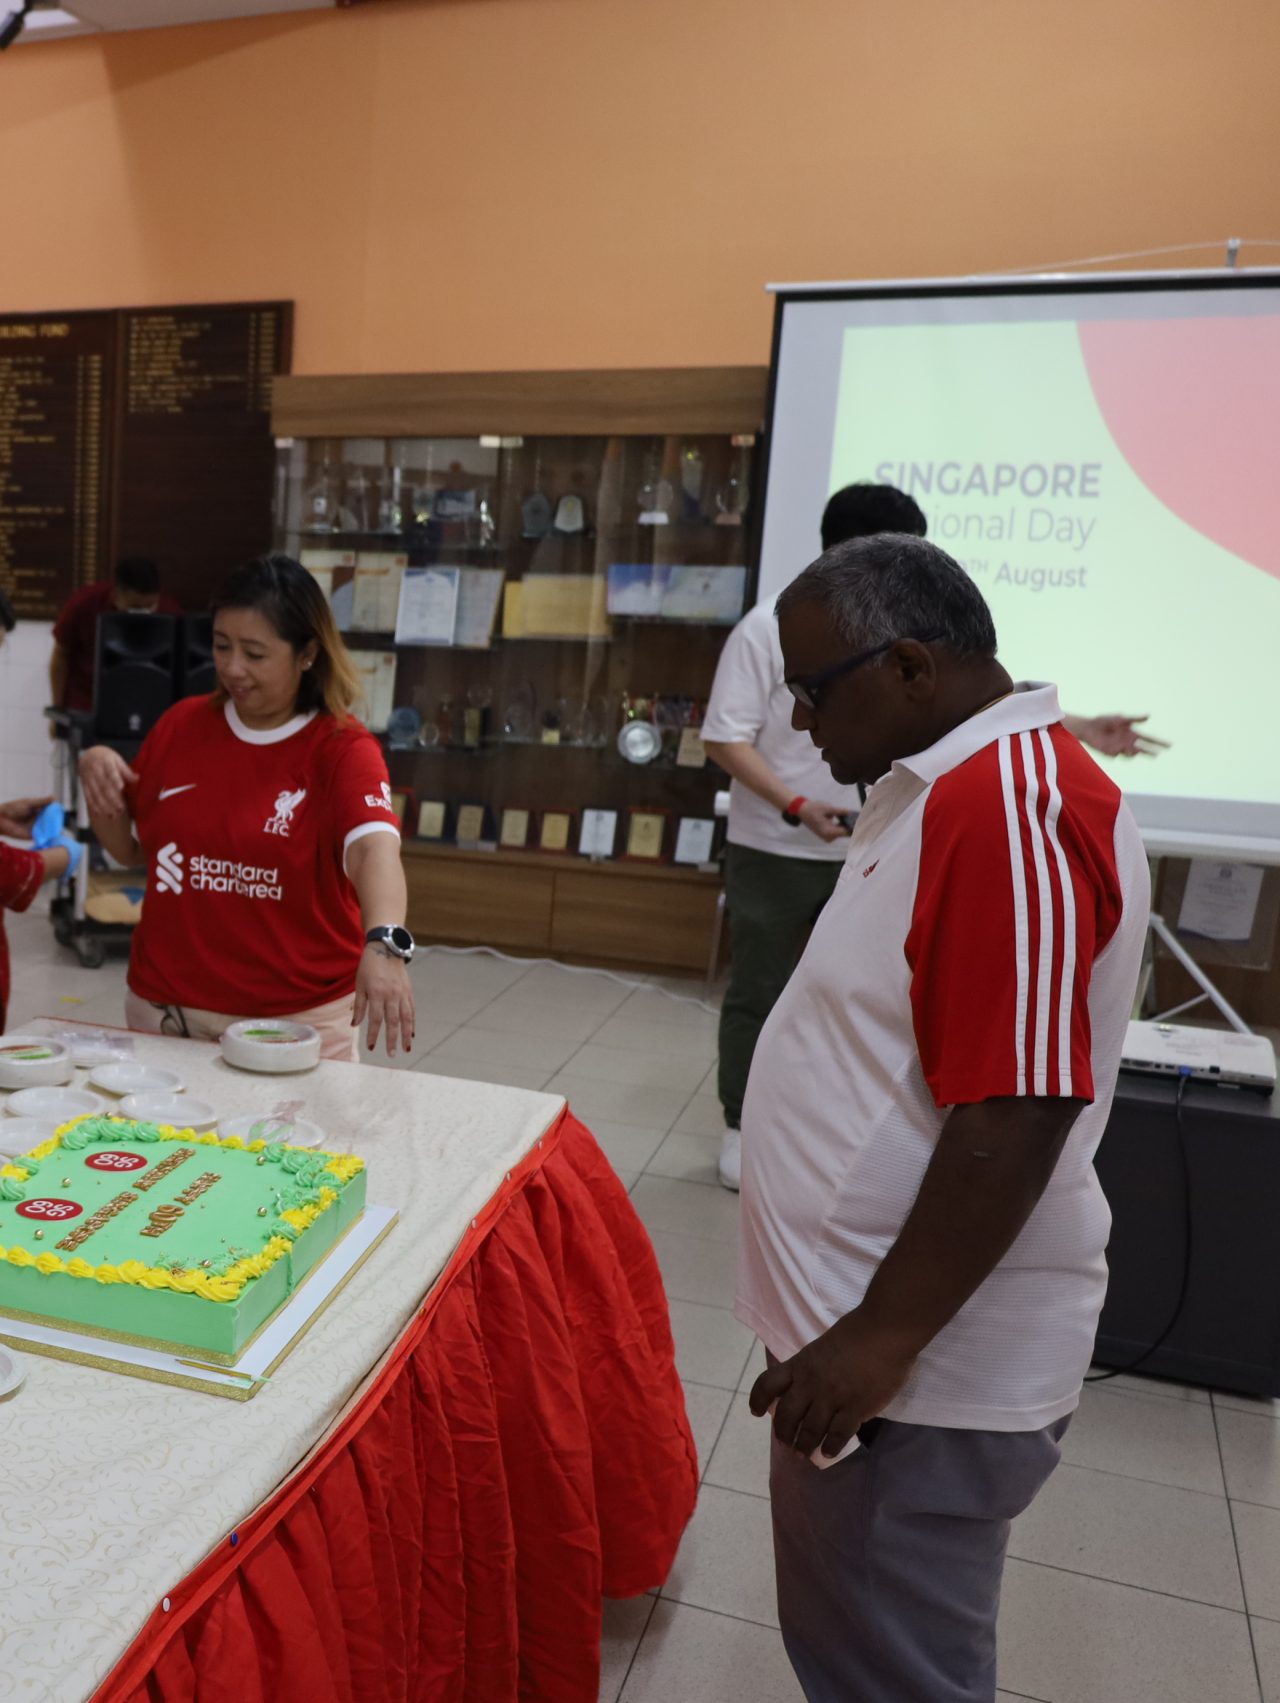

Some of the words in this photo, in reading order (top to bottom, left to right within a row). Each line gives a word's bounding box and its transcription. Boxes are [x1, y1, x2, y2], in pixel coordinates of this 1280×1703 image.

[875, 461, 1102, 498] SINGAPORE
[1027, 508, 1097, 551] Day
[993, 561, 1087, 592] August
[189, 854, 278, 885] standard
[190, 873, 283, 901] chartered
